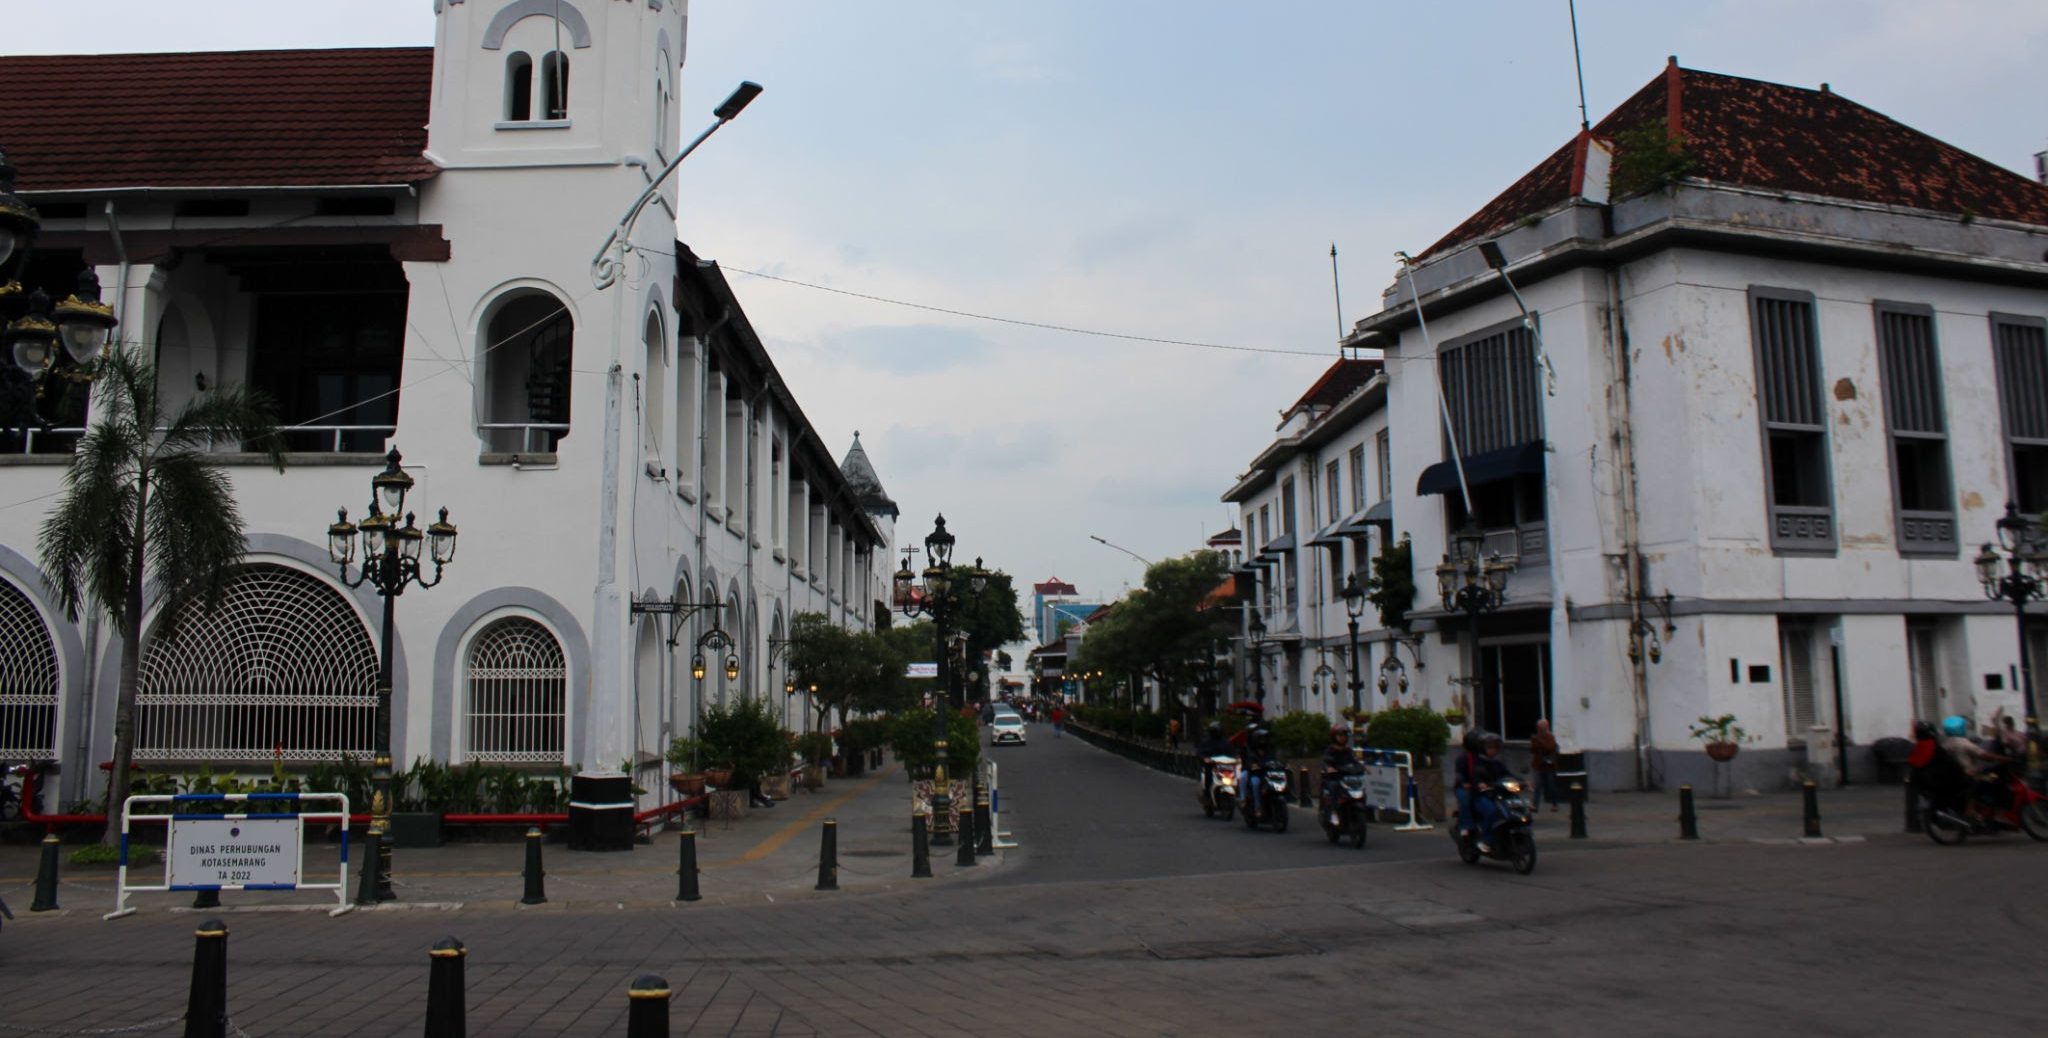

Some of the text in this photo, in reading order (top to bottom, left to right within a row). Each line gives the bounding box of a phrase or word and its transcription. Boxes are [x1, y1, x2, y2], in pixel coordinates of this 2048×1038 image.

[190, 845, 281, 855] DINAS PERHUBUNGAN
[218, 871, 251, 880] TA 2022
